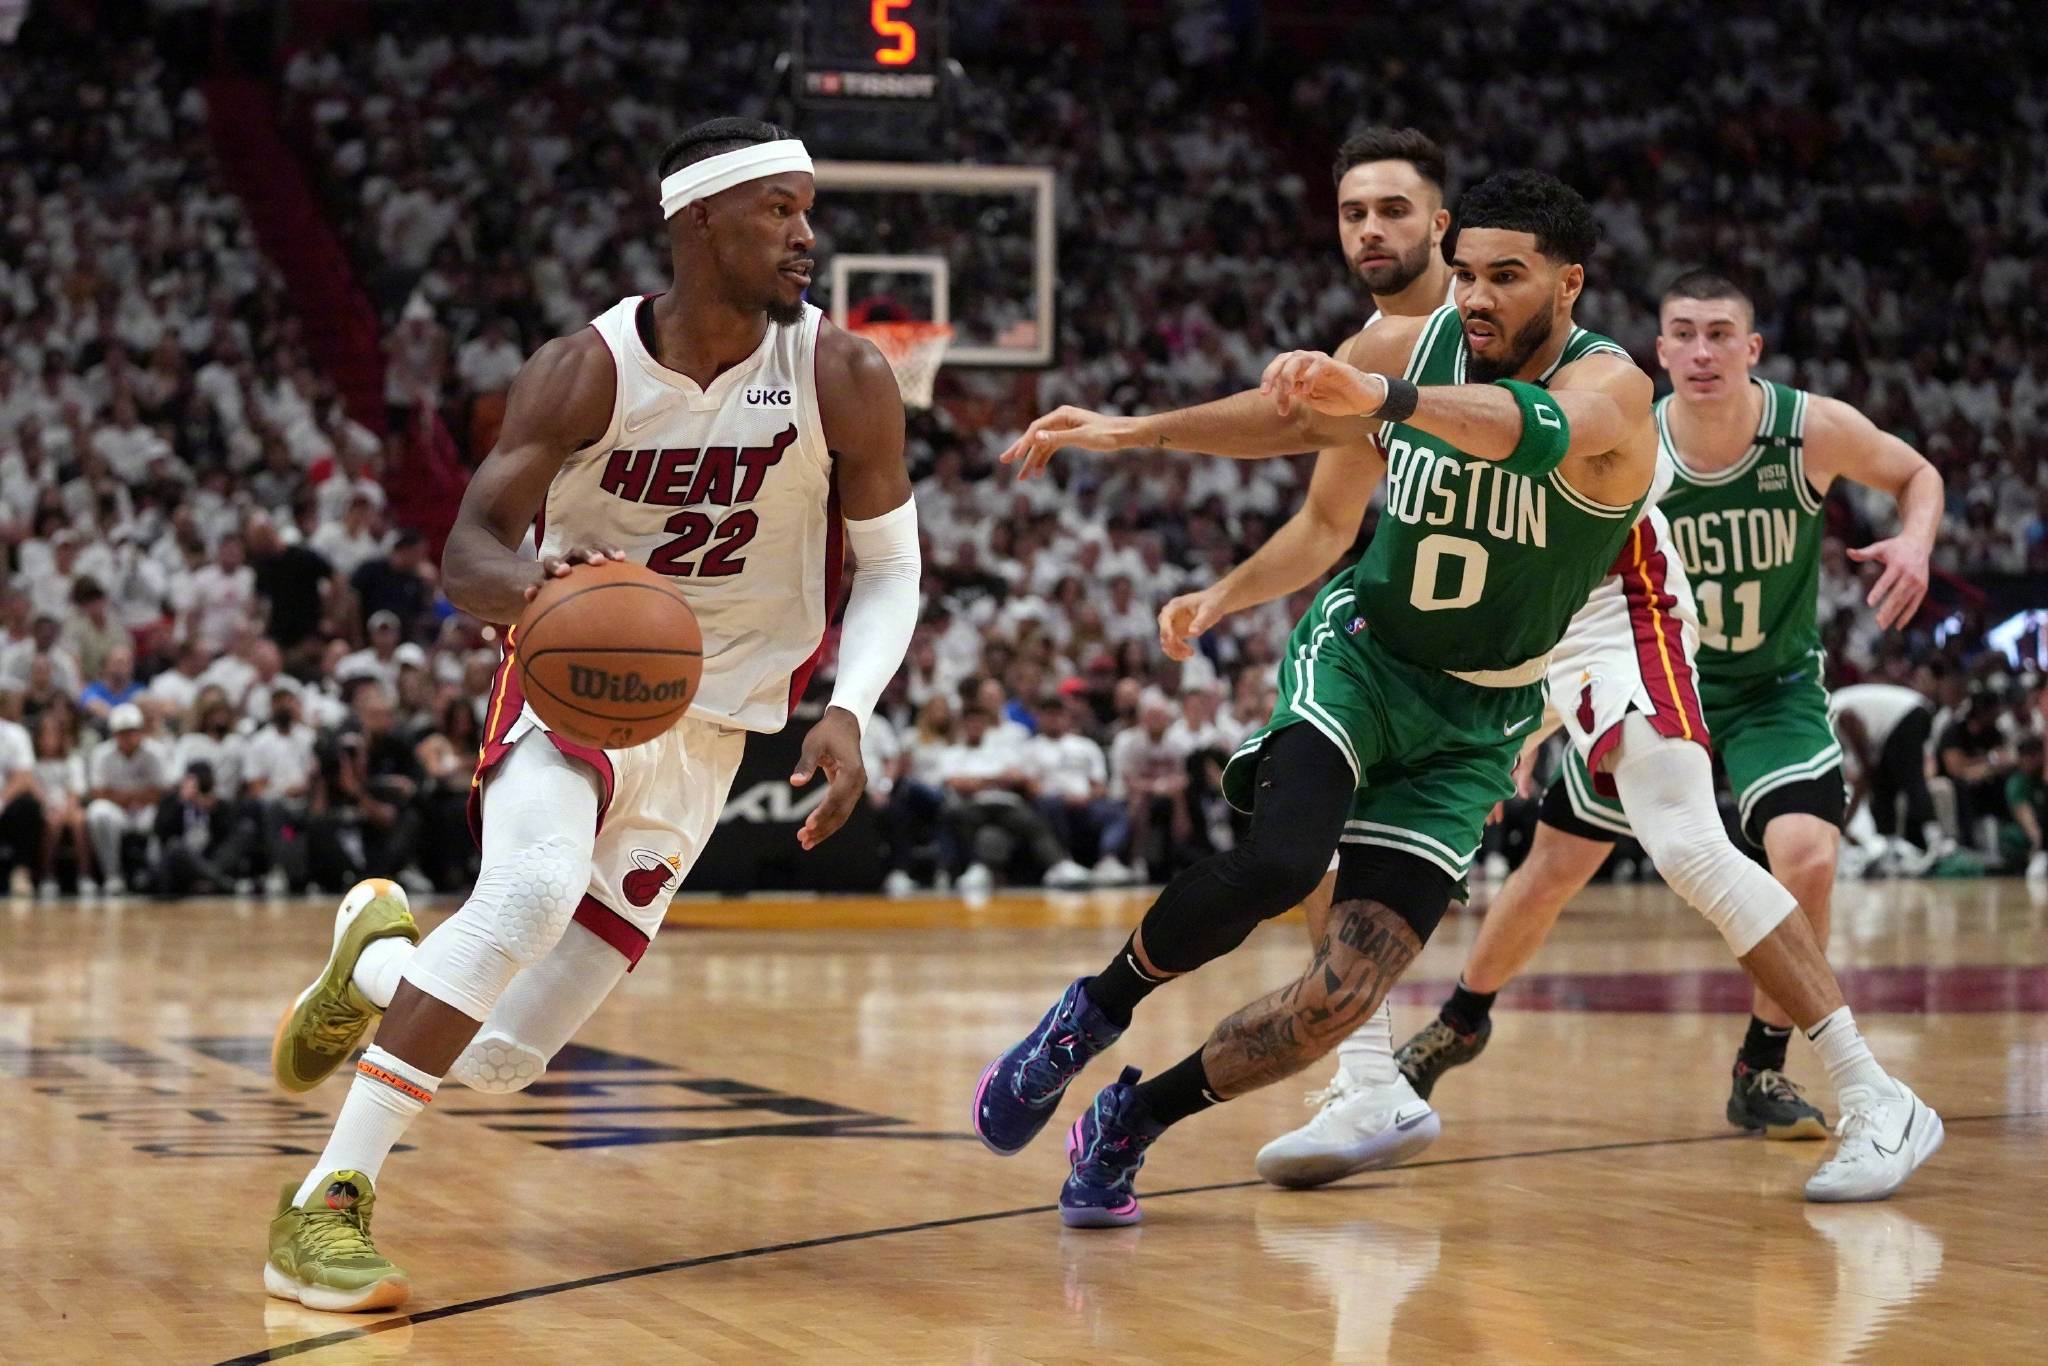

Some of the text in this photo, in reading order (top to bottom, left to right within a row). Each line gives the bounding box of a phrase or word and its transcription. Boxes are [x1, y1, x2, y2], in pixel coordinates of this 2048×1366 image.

[871, 0, 916, 65] 5
[600, 422, 798, 507] HEAT
[1387, 438, 1547, 548] BOSTON
[1756, 464, 1788, 481] VISTA
[646, 508, 759, 577] 22
[1409, 533, 1489, 611] 0
[1669, 508, 1798, 576] OSTON
[1696, 579, 1766, 654] 11
[567, 663, 688, 704] Wilson
